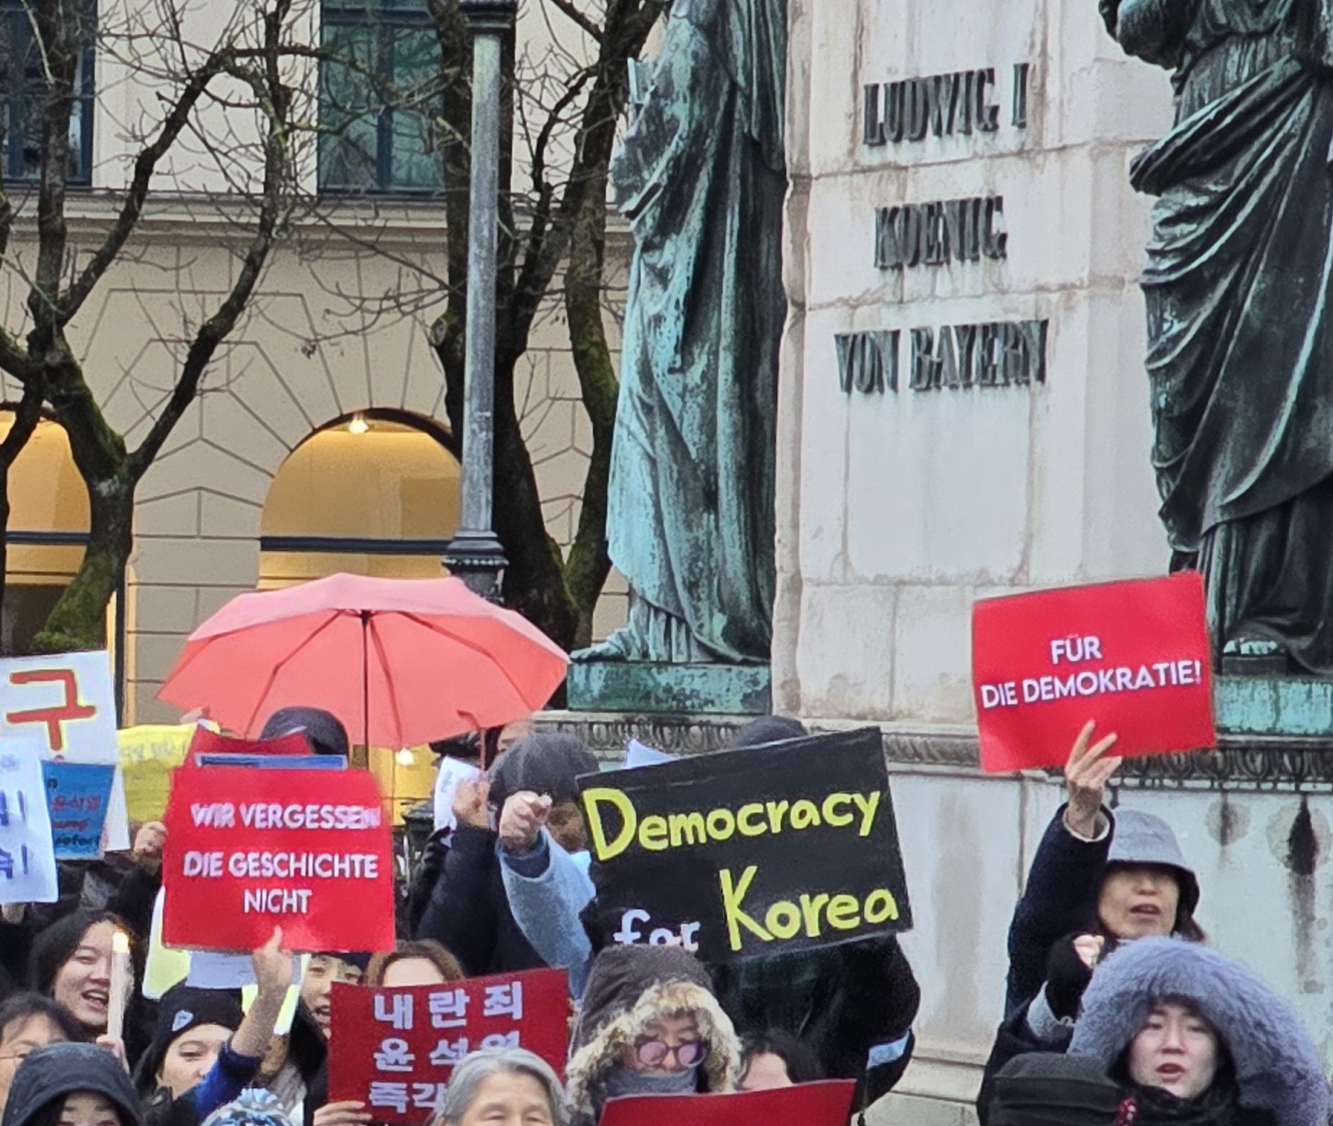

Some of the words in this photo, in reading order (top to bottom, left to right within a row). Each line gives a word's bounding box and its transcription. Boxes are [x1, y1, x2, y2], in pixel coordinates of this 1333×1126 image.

[873, 196, 1008, 269] KOENIG
[834, 329, 901, 394] VON
[909, 318, 1049, 393] BAYERN
[1050, 633, 1103, 665] FÜR
[981, 681, 1018, 710] DIE
[1022, 658, 1203, 704] DEMOKRATIE!
[190, 802, 235, 828] WIR
[239, 802, 381, 830] VERGESSEN
[581, 786, 881, 862] Democracy
[183, 851, 224, 878] DIE
[228, 851, 379, 879] GESCHICHTE
[243, 888, 313, 914] NICHT
[614, 908, 701, 953] for
[718, 864, 899, 952] Korea
[373, 981, 523, 1030] 내란죄
